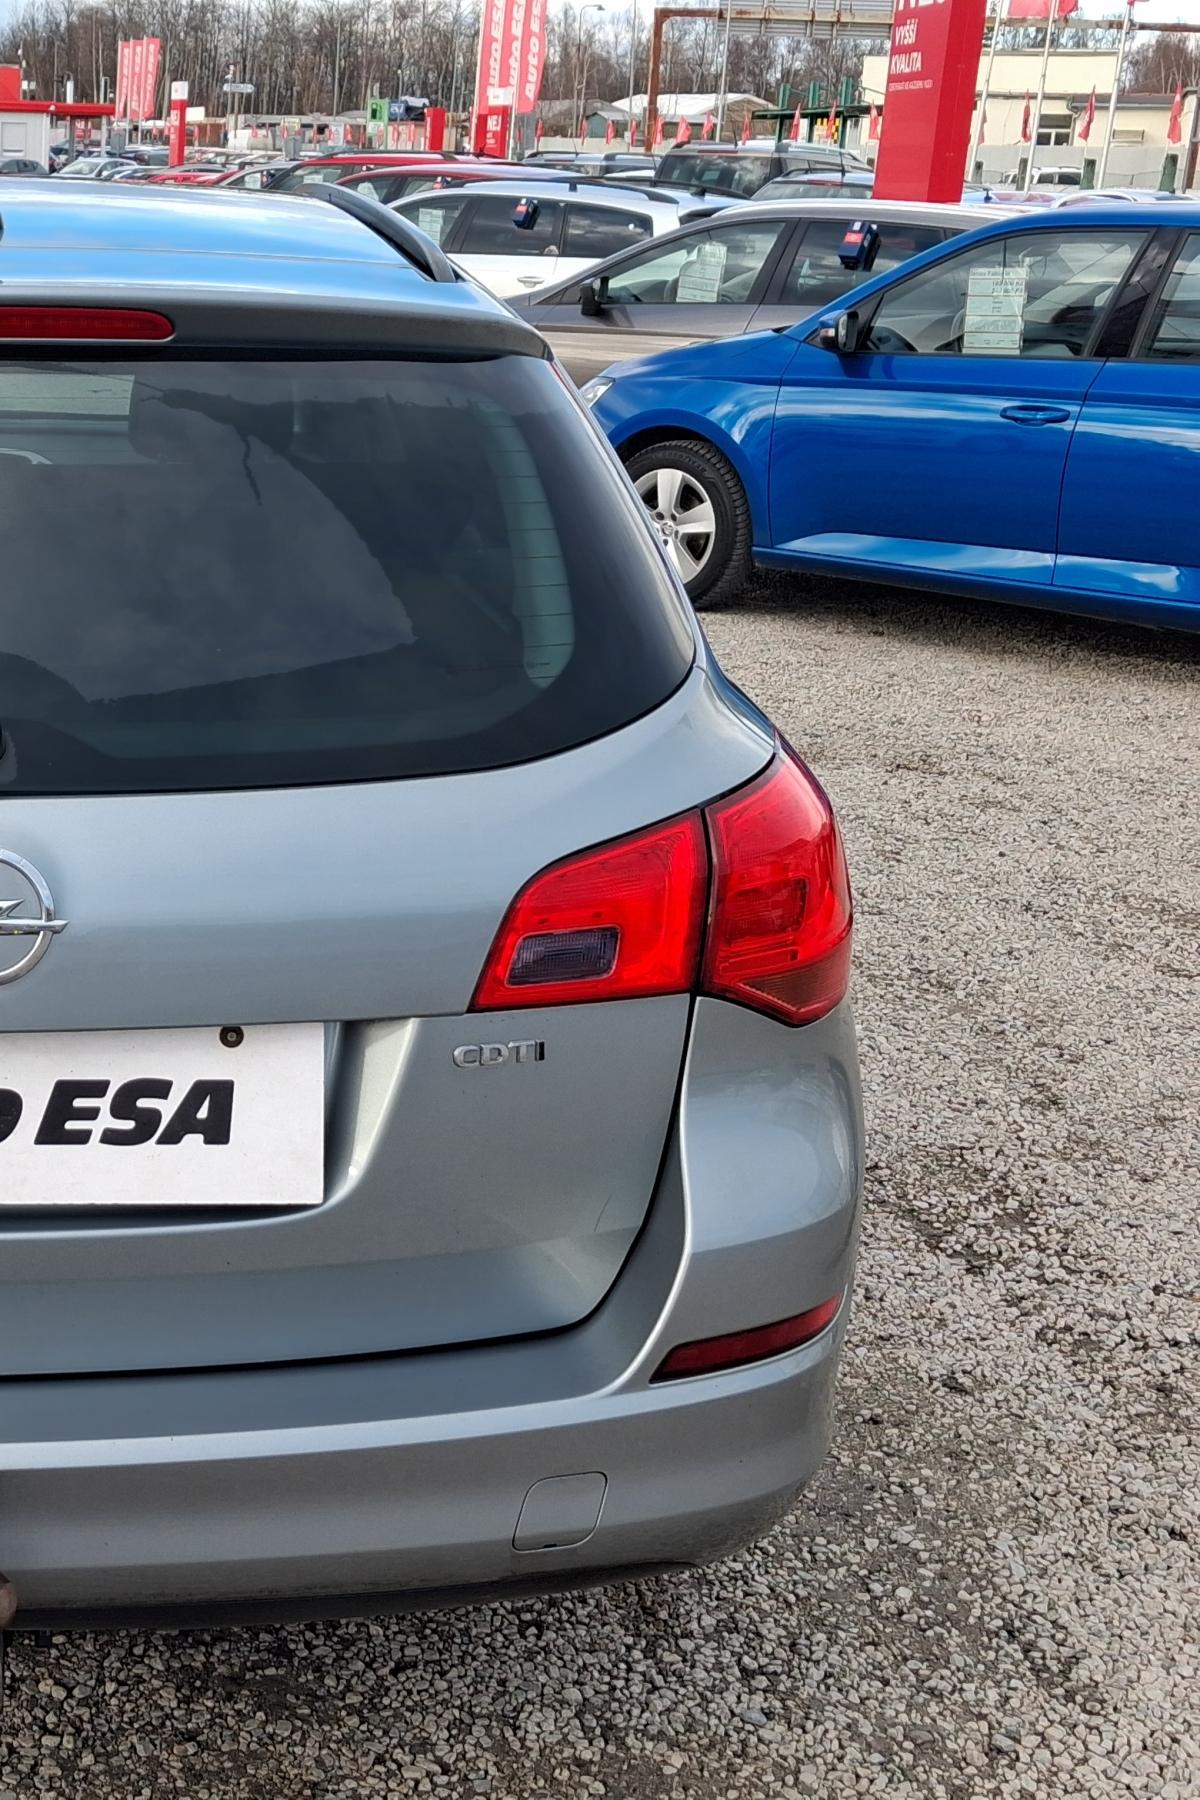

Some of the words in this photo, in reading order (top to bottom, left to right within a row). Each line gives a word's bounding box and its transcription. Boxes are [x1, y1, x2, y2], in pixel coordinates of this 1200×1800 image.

[530, 0, 542, 33] ES
[895, 18, 918, 47] VYŠŠÍ
[890, 51, 922, 75] KVALITA
[453, 1040, 545, 1068] CDTI
[33, 1077, 235, 1145] ESA
